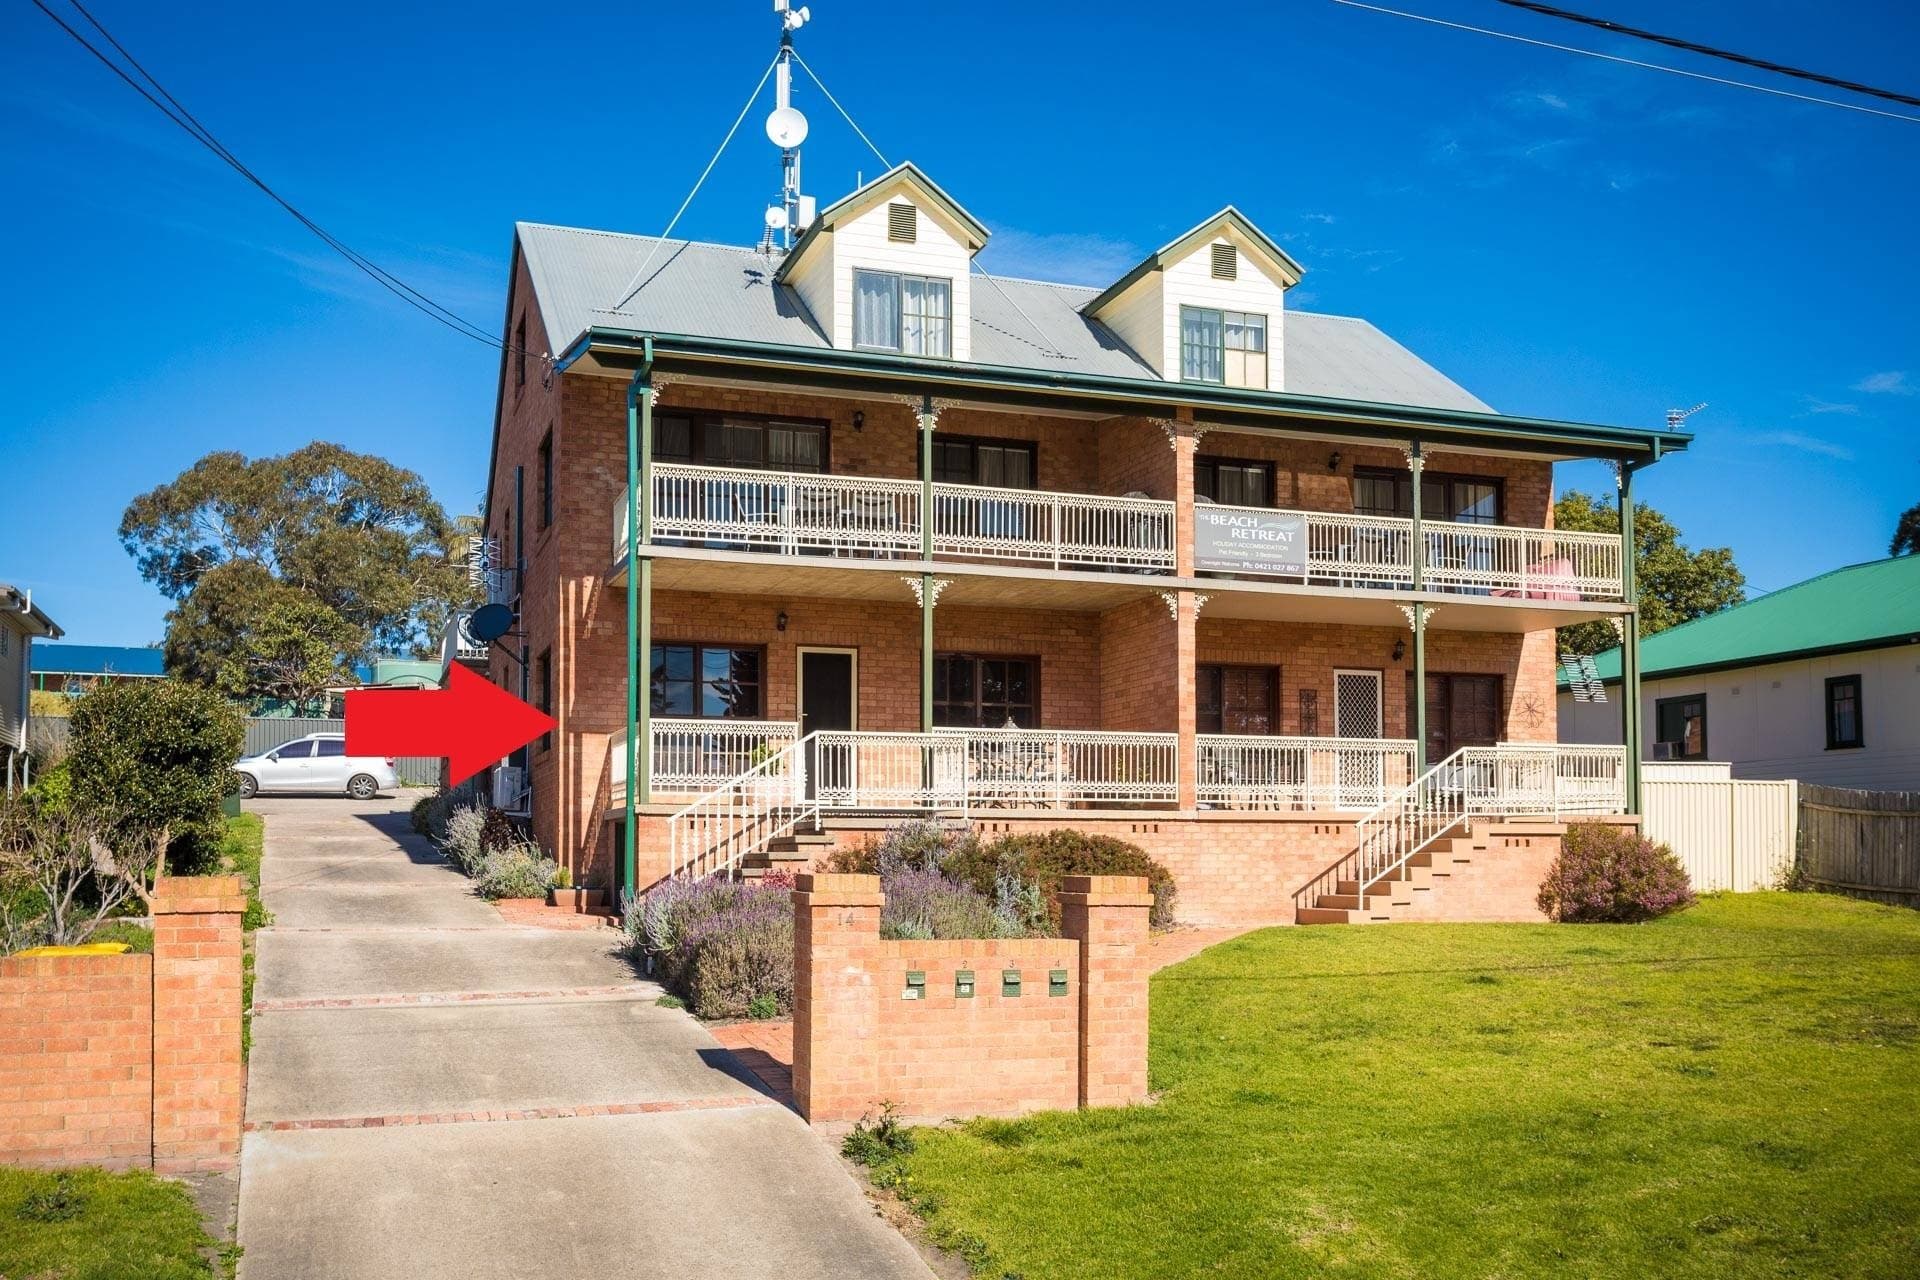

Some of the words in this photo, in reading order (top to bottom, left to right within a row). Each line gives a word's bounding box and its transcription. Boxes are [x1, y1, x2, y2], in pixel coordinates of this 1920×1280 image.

[1210, 514, 1258, 528] BEACH
[1232, 528, 1295, 542] RETREAT
[1254, 562, 1271, 570] 0421
[838, 912, 855, 926] 14
[962, 960, 968, 969] 2
[1009, 959, 1015, 968] 3
[1055, 959, 1060, 967] 4
